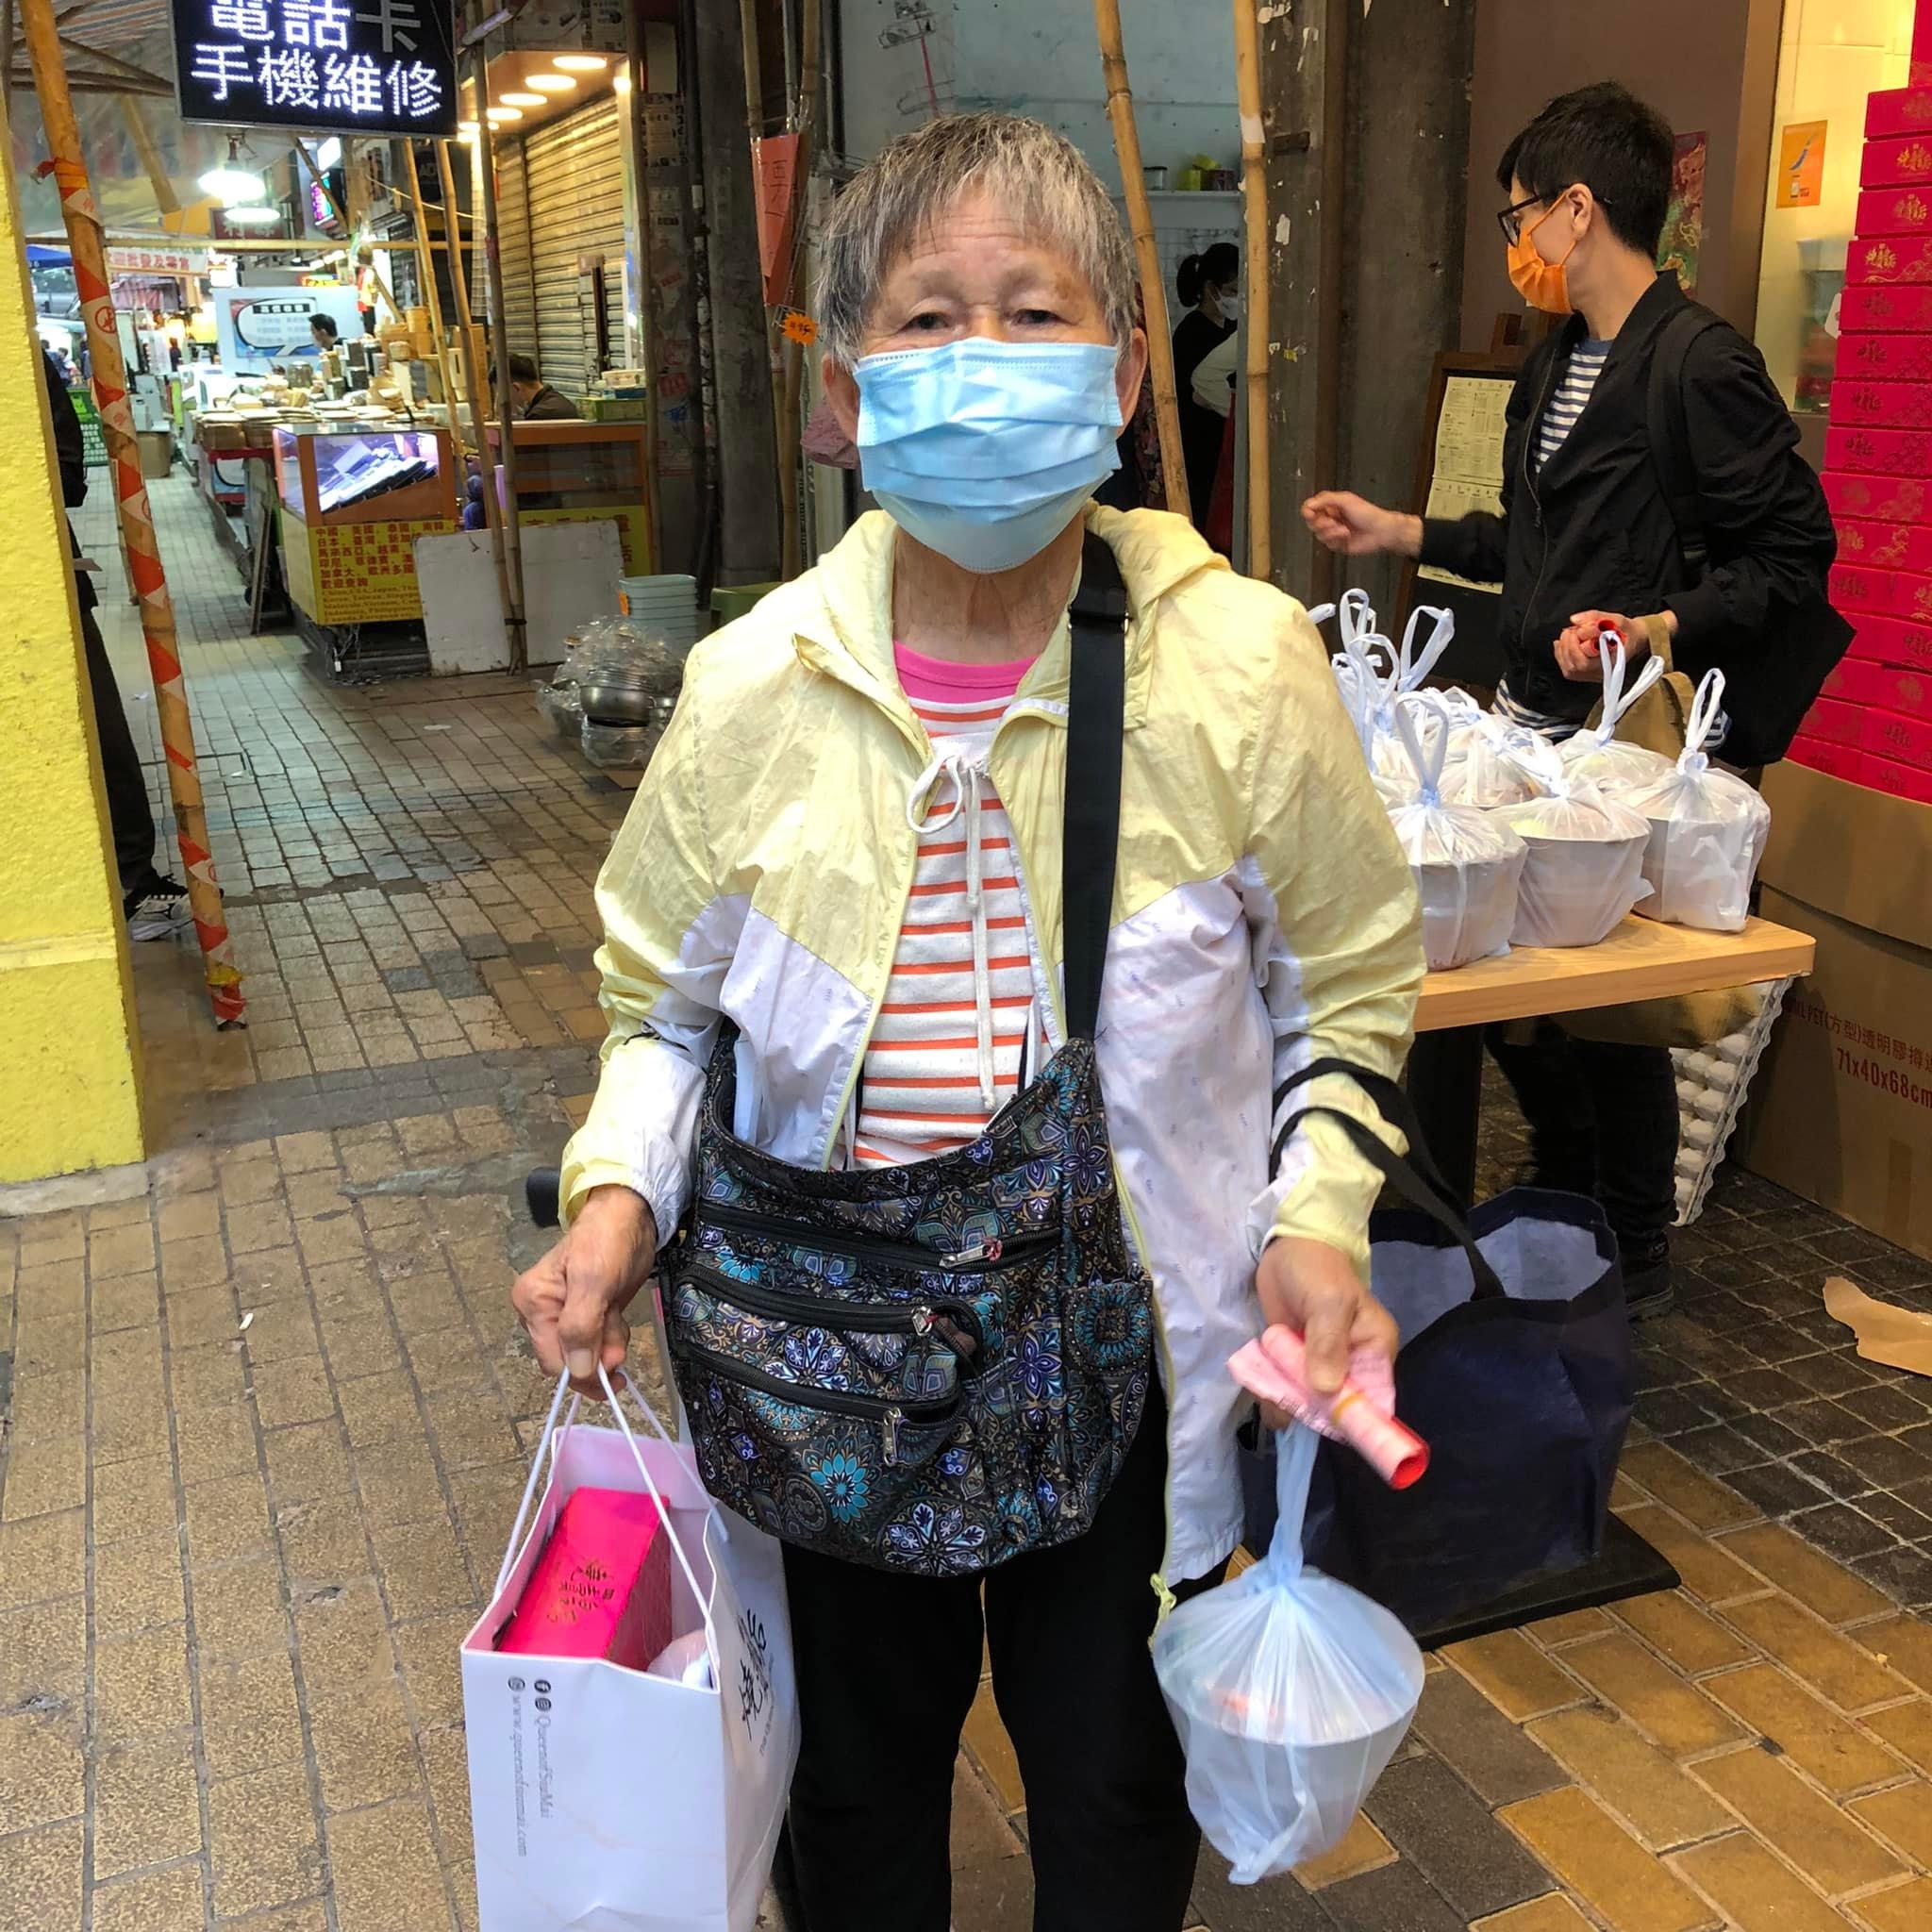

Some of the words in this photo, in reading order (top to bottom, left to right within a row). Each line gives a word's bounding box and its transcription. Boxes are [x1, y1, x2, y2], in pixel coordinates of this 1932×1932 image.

[191, 44, 442, 117] 手機維修
[1836, 1046, 1932, 1109] 71x40x68cm
